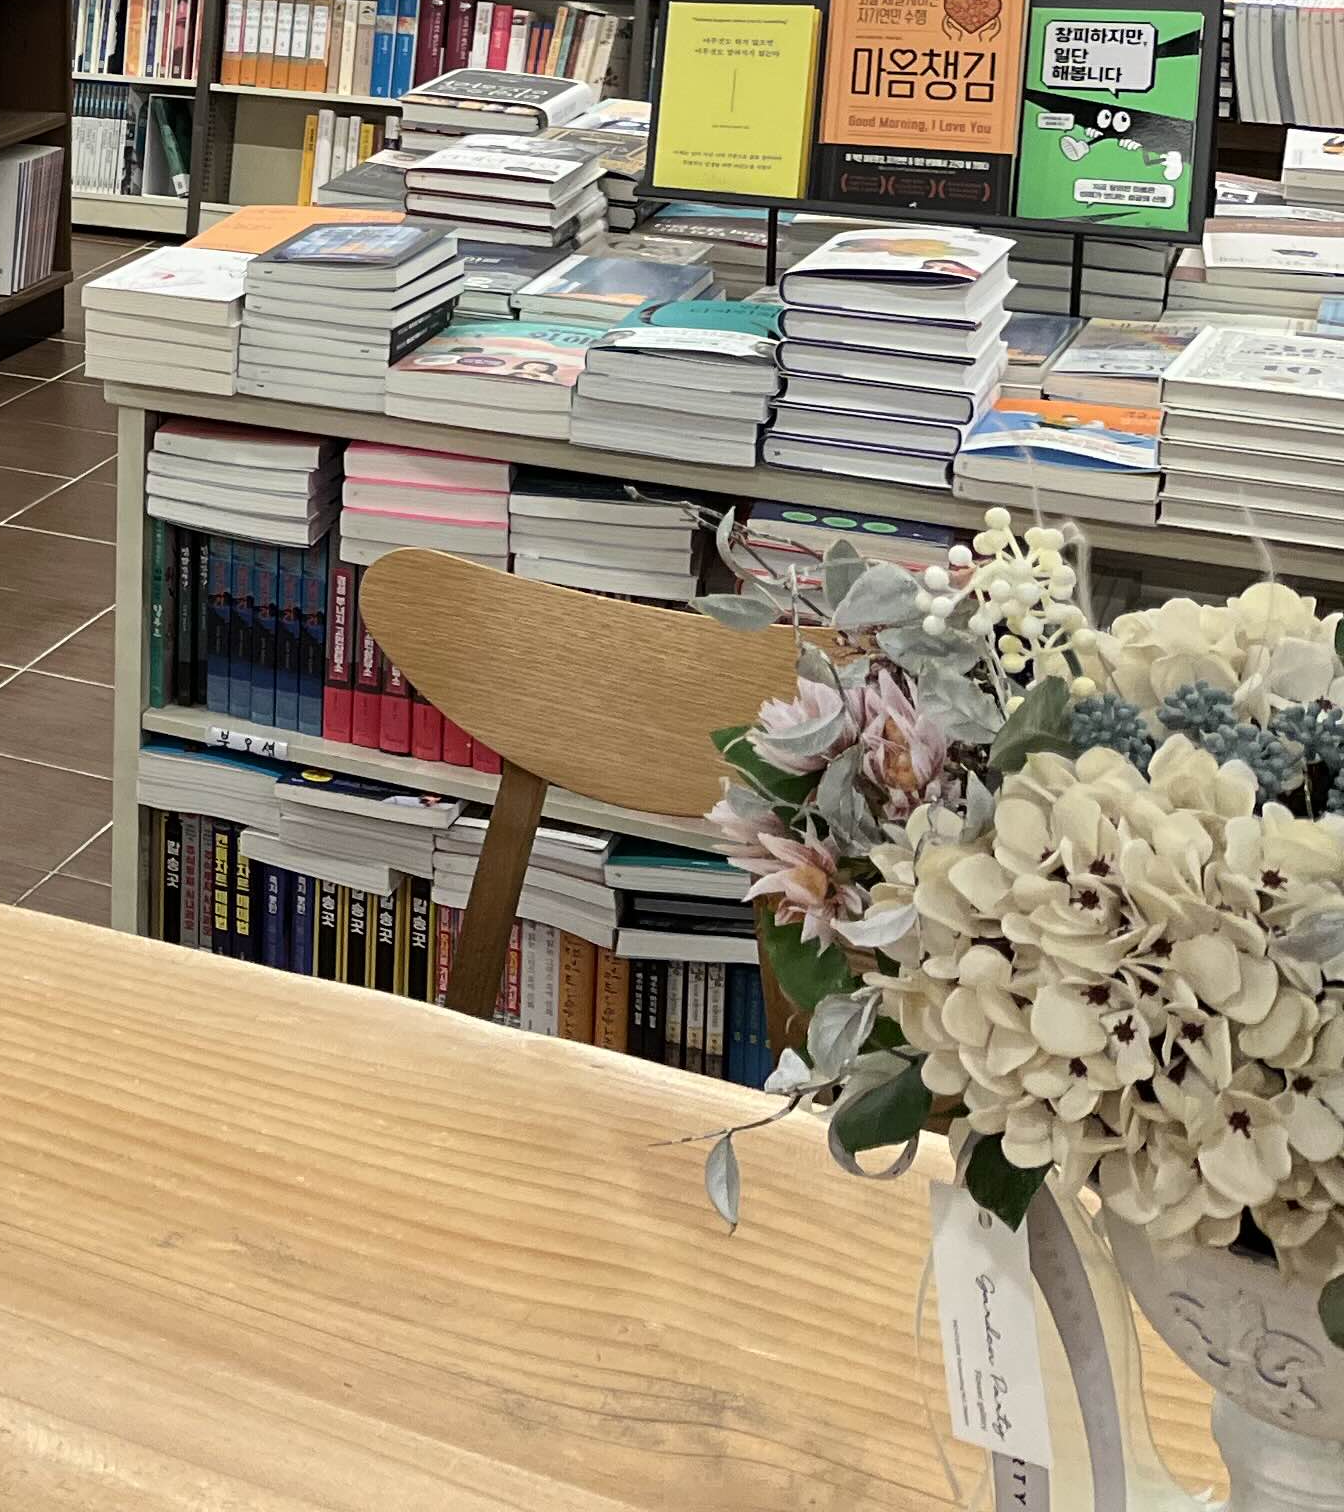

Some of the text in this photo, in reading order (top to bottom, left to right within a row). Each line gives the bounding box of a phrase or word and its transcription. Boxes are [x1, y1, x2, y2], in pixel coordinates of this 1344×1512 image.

[856, 8, 928, 26] 자기연민 수행
[1055, 28, 1148, 46] 창피하지만,
[1054, 48, 1089, 64] 일단
[851, 48, 996, 102] 마음챙김
[1052, 66, 1123, 83] 해봅니다
[849, 115, 876, 128] Good
[879, 116, 928, 133] Morning,
[939, 118, 965, 133] Love
[970, 120, 991, 134] You
